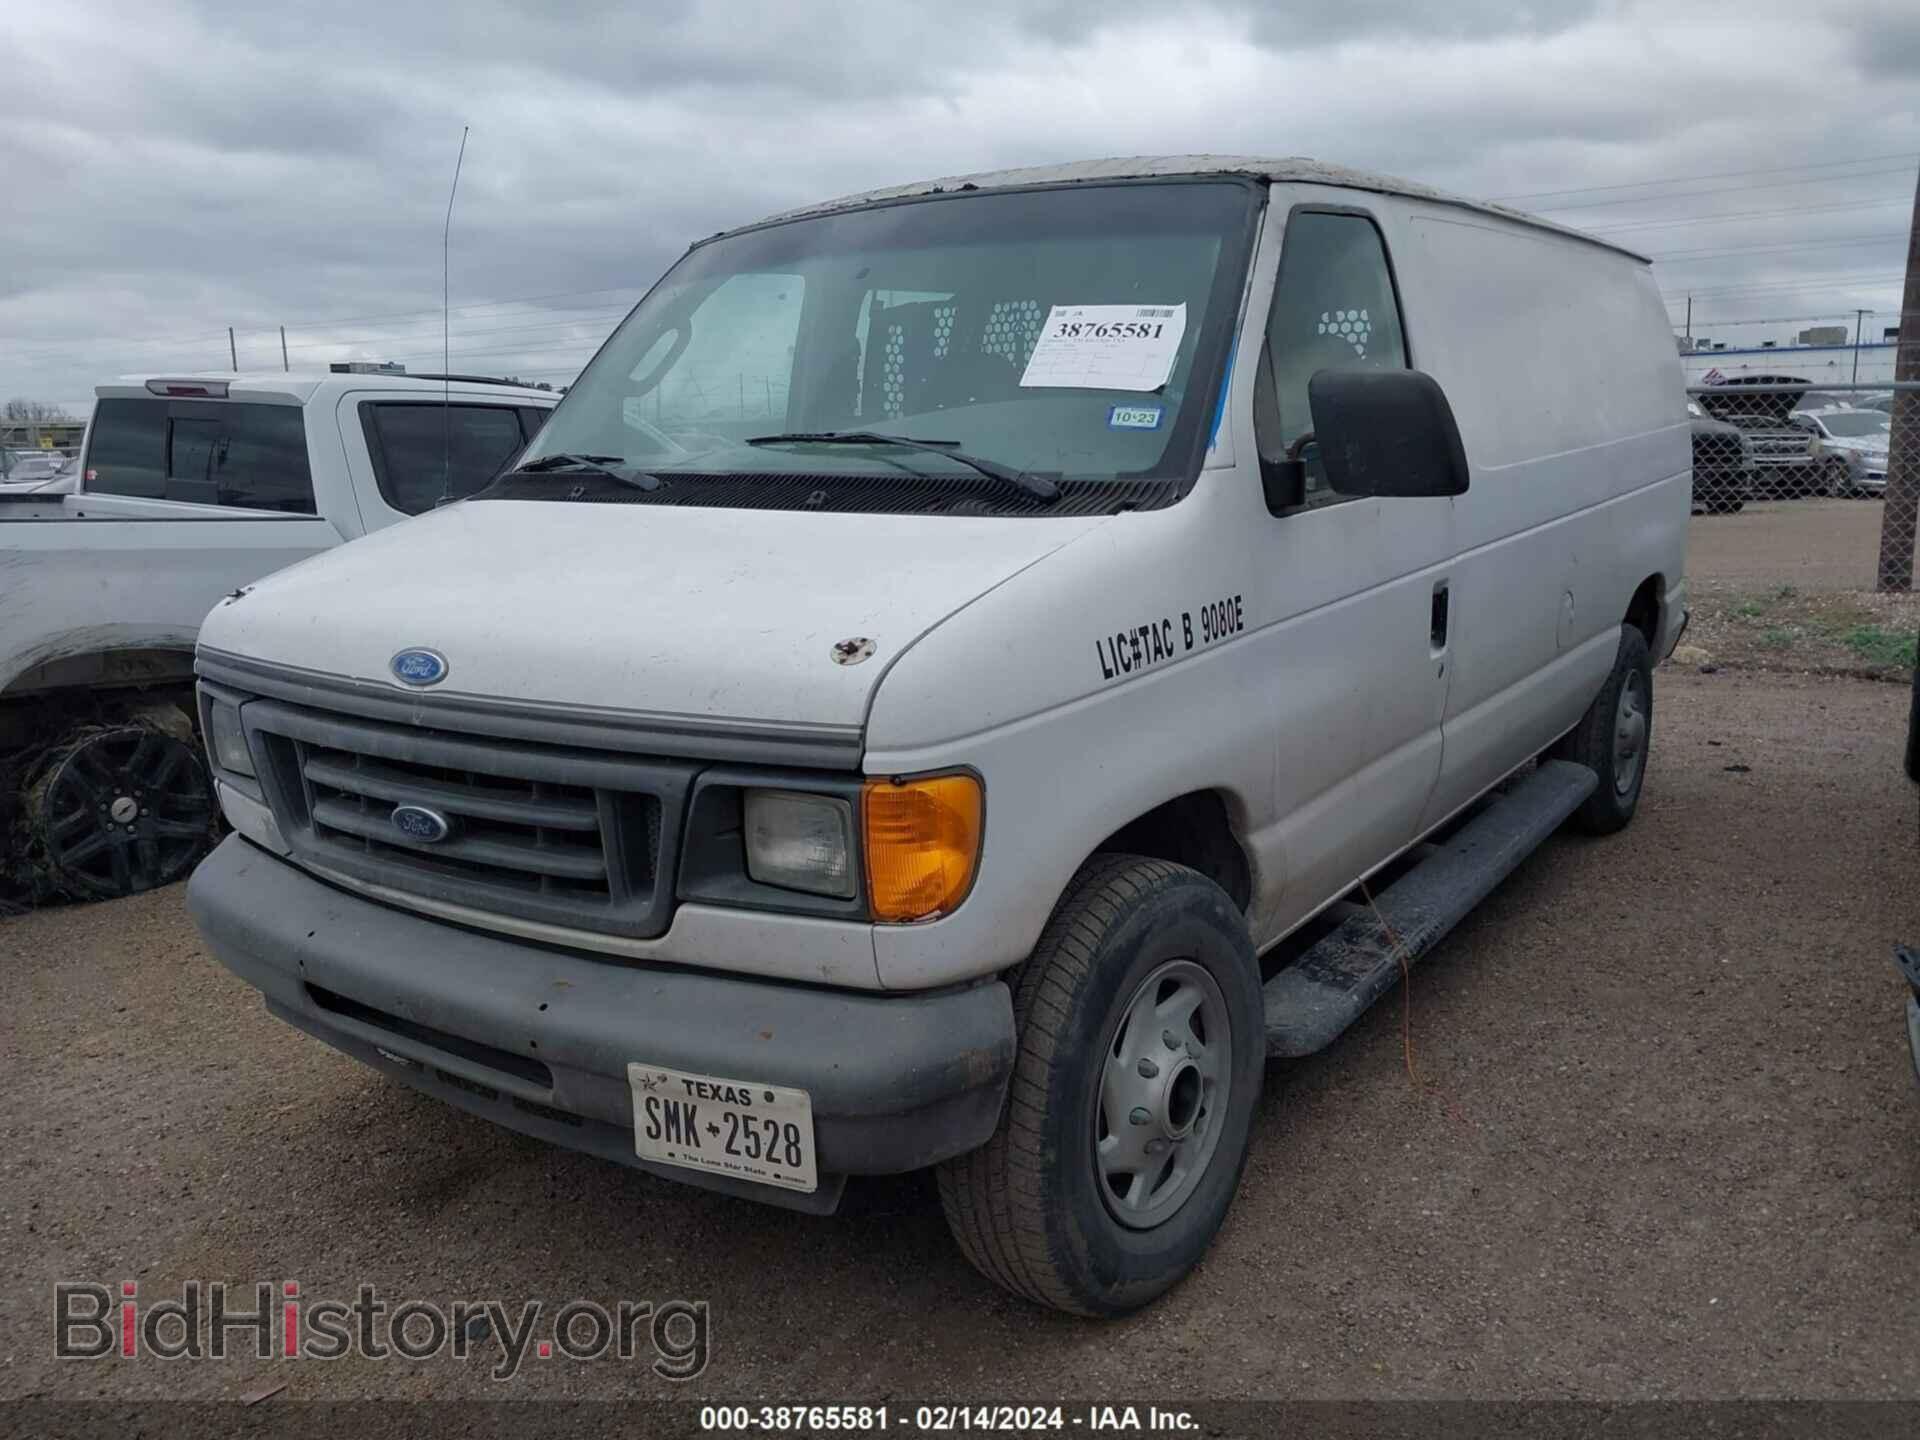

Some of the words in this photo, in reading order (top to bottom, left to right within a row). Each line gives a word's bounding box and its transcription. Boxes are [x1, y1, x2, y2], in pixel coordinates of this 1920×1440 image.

[1053, 322, 1164, 339] 38765581
[1096, 618, 1174, 680] LIC#TAC
[1182, 612, 1193, 650] B
[1201, 595, 1244, 643] 9080E
[400, 657, 433, 677] Ford
[402, 813, 432, 835] Ford
[681, 1078, 752, 1106] TEXAS
